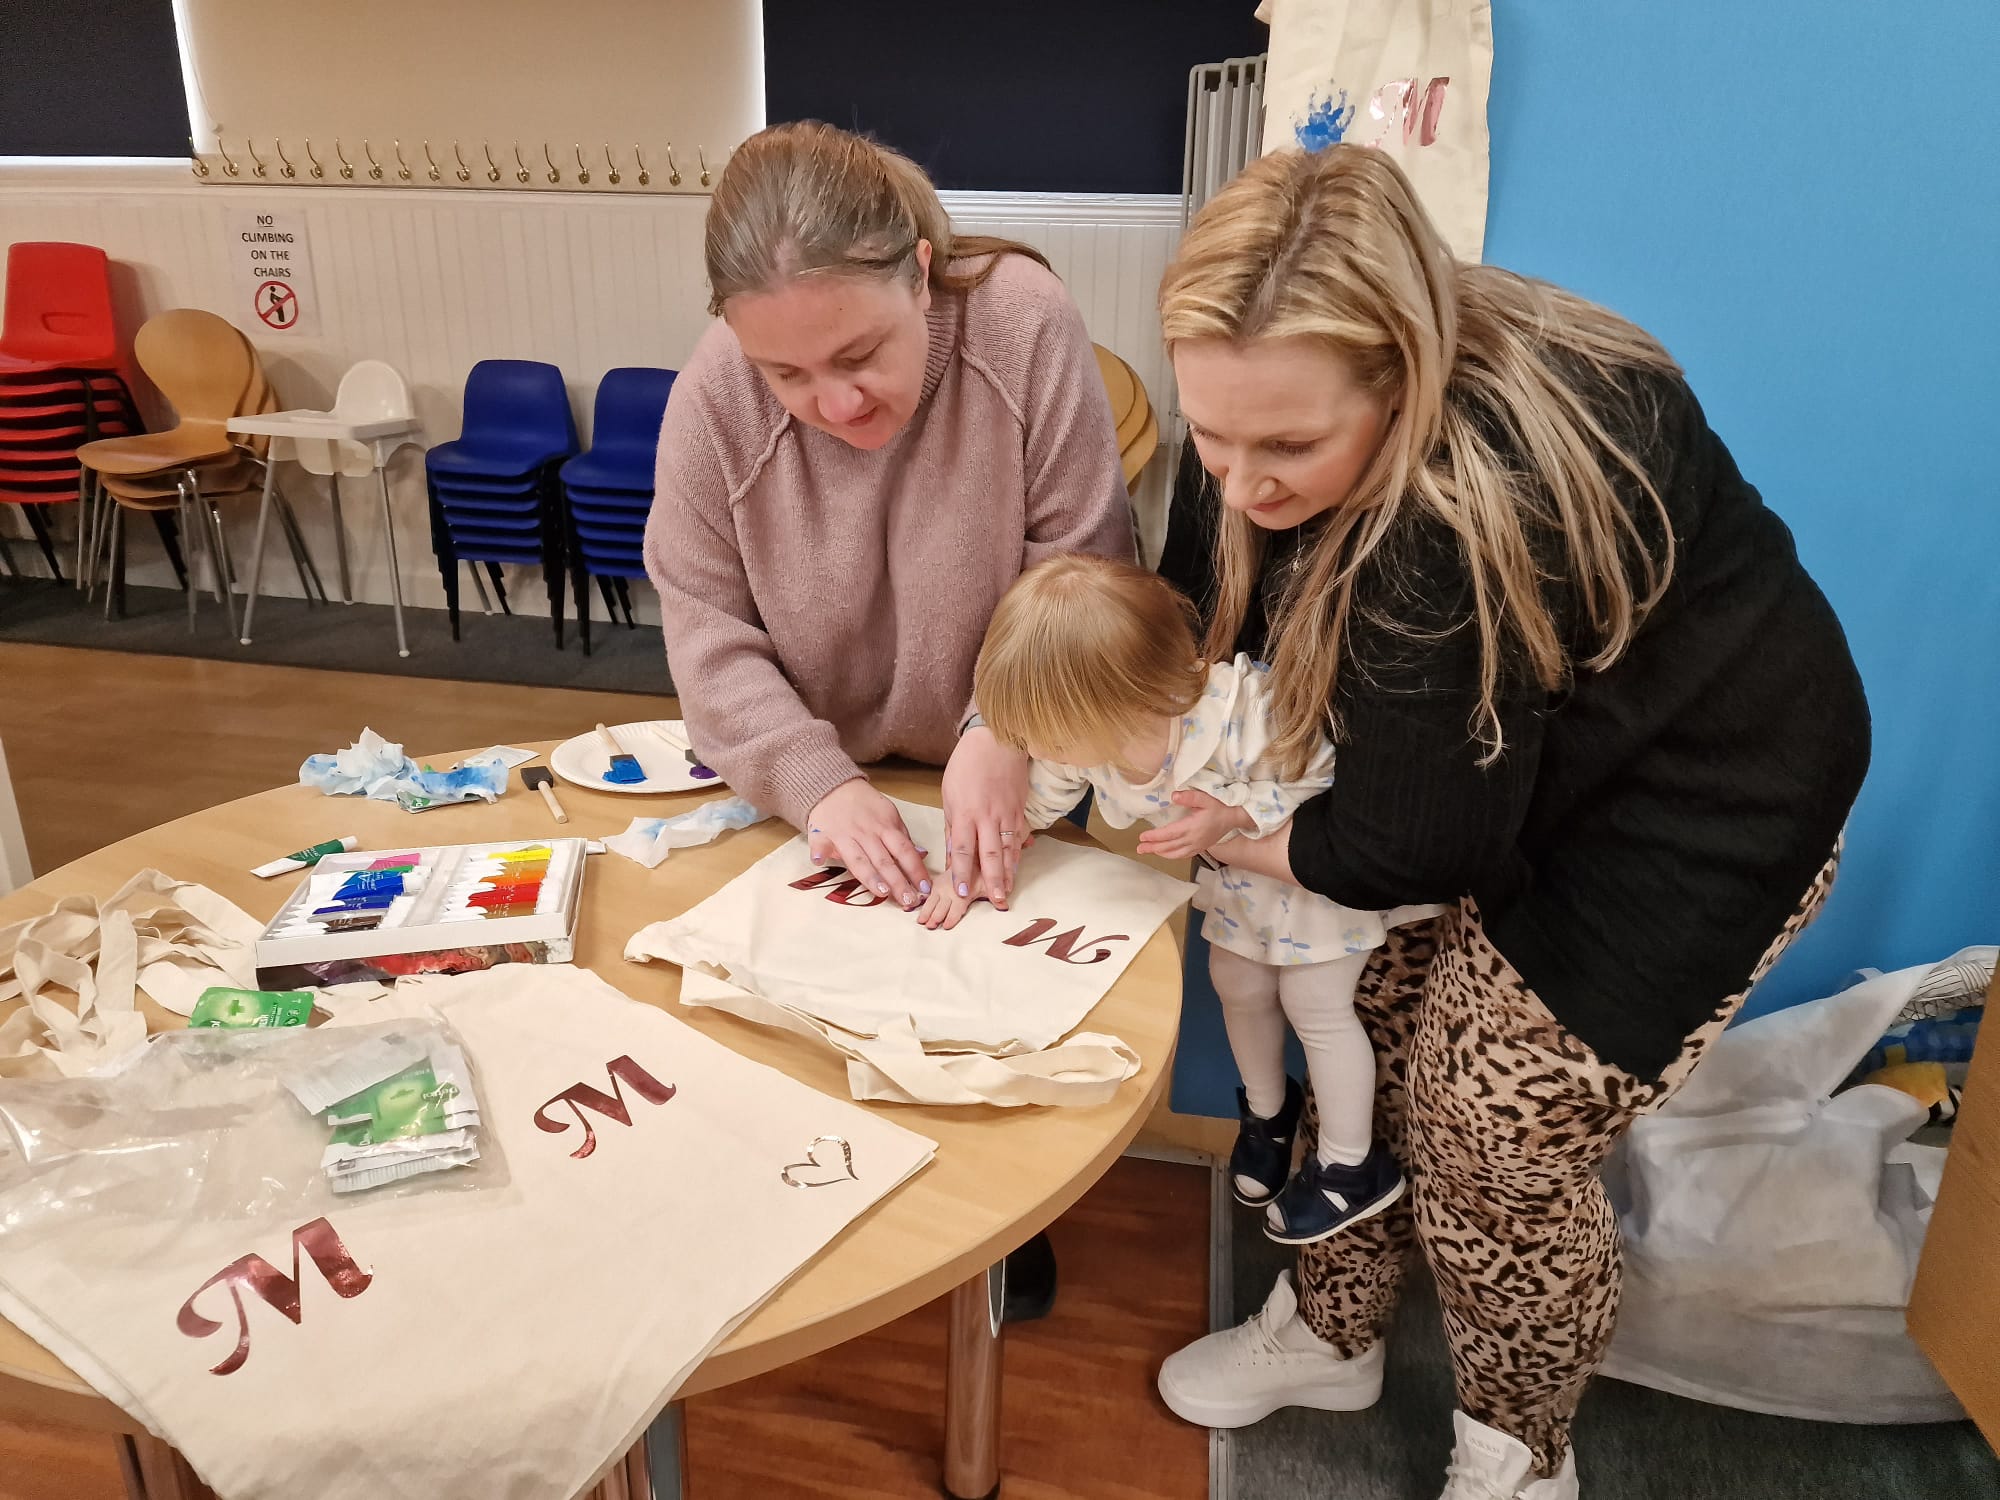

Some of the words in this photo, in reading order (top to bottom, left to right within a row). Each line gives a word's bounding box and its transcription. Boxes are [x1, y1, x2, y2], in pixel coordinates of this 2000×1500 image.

[256, 215, 274, 228] NO
[241, 232, 294, 243] CLIMBING
[250, 249, 267, 260] ON
[270, 250, 290, 260] THE
[253, 267, 291, 277] CHAIRS
[533, 1054, 677, 1160] M
[176, 1216, 374, 1376] M
